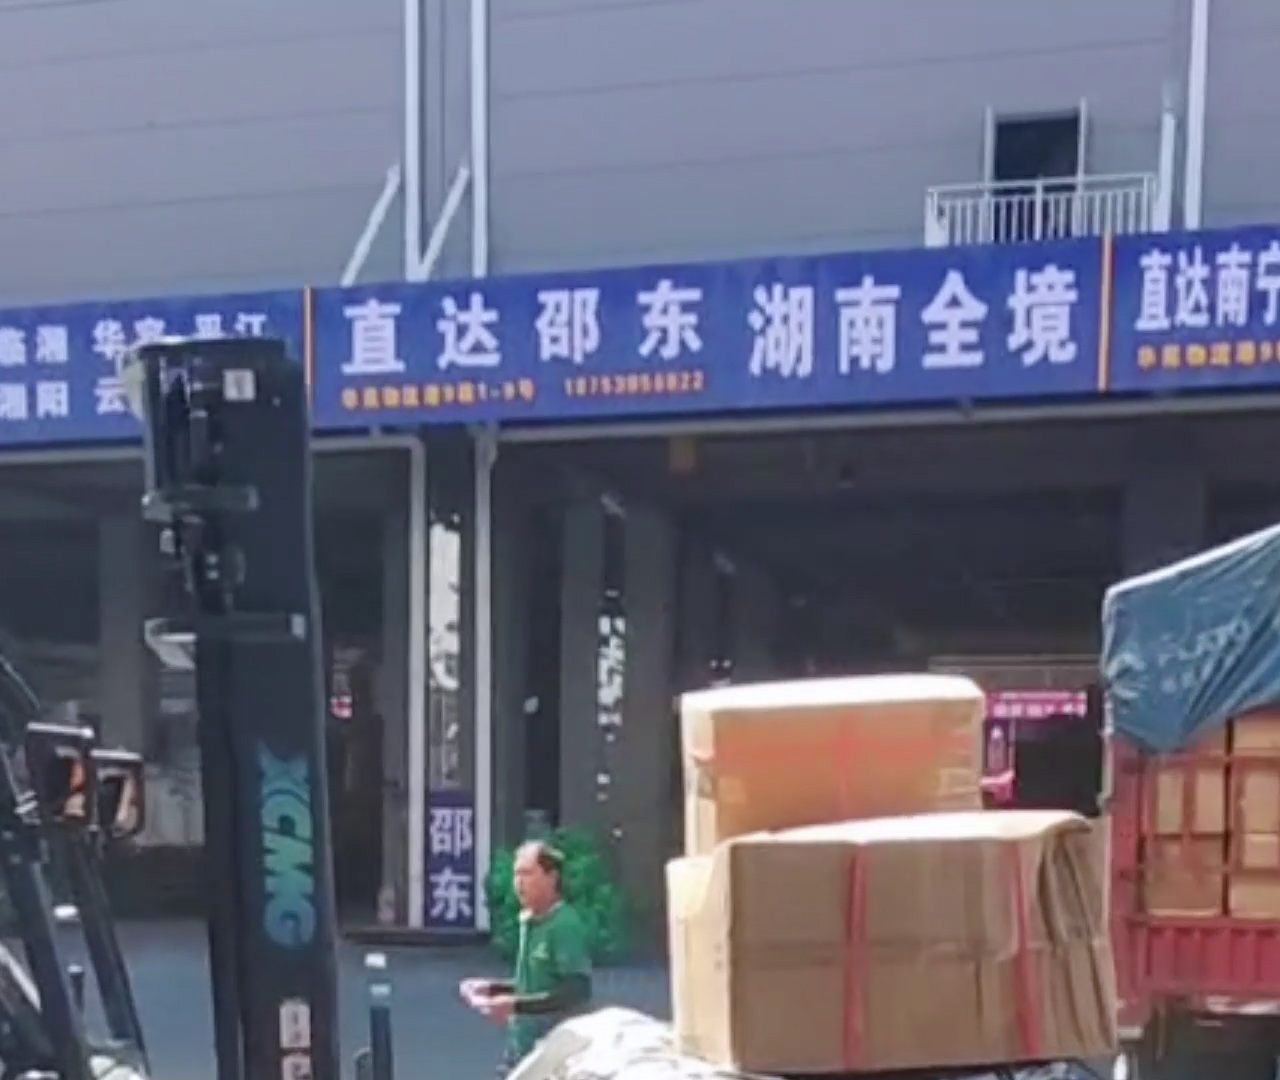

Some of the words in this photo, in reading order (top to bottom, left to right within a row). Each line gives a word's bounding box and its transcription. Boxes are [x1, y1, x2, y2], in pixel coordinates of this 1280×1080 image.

[339, 280, 702, 375] 直达邵东
[748, 265, 1077, 377] 湖南全境
[257, 741, 317, 946] XCMG
[429, 808, 473, 920] 邵东
